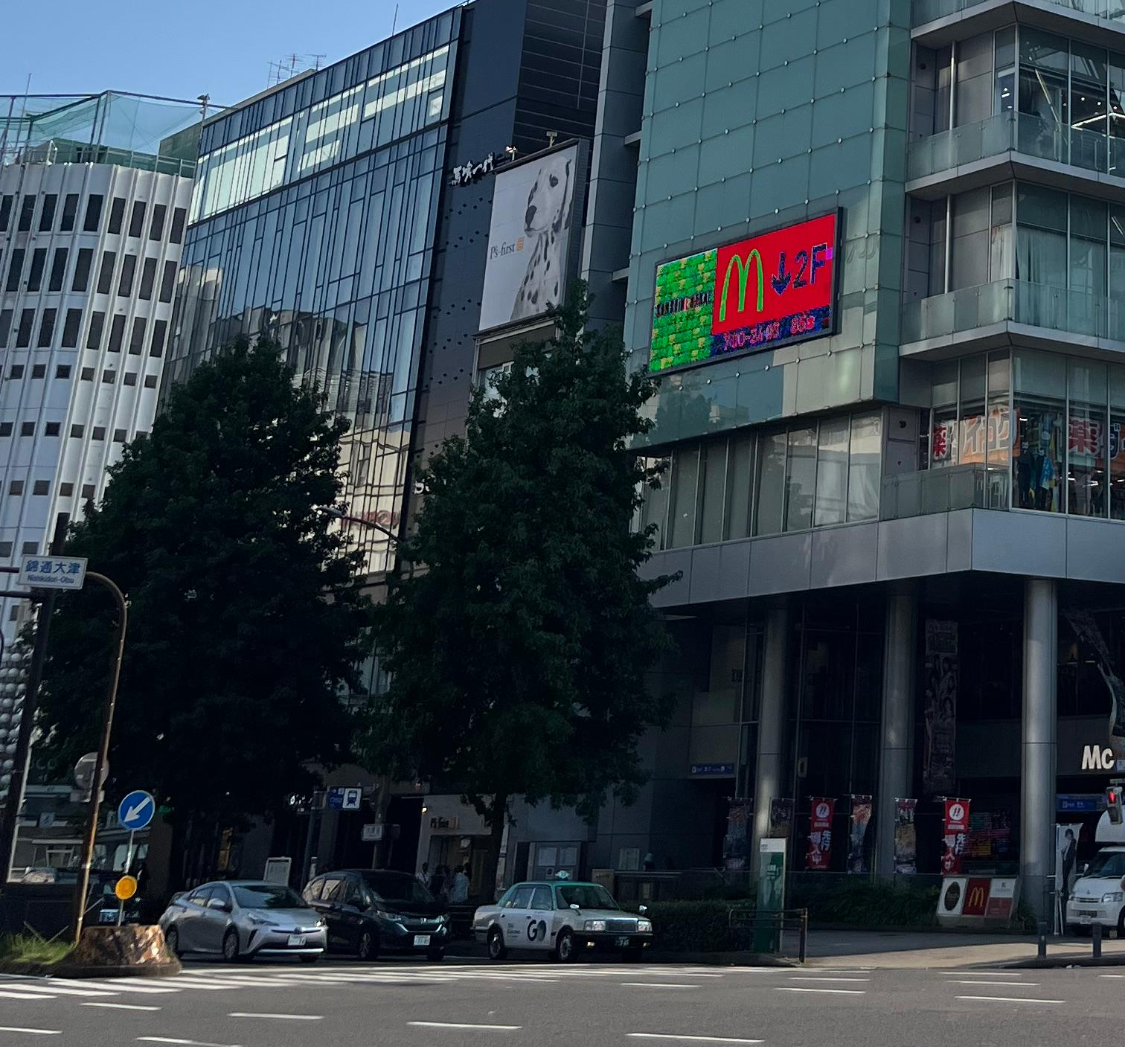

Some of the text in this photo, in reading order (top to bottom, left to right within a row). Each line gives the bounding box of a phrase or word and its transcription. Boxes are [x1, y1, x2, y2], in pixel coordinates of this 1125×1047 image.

[793, 243, 828, 288] 2F
[26, 559, 80, 575] 錦通大津
[527, 919, 547, 942] GO
